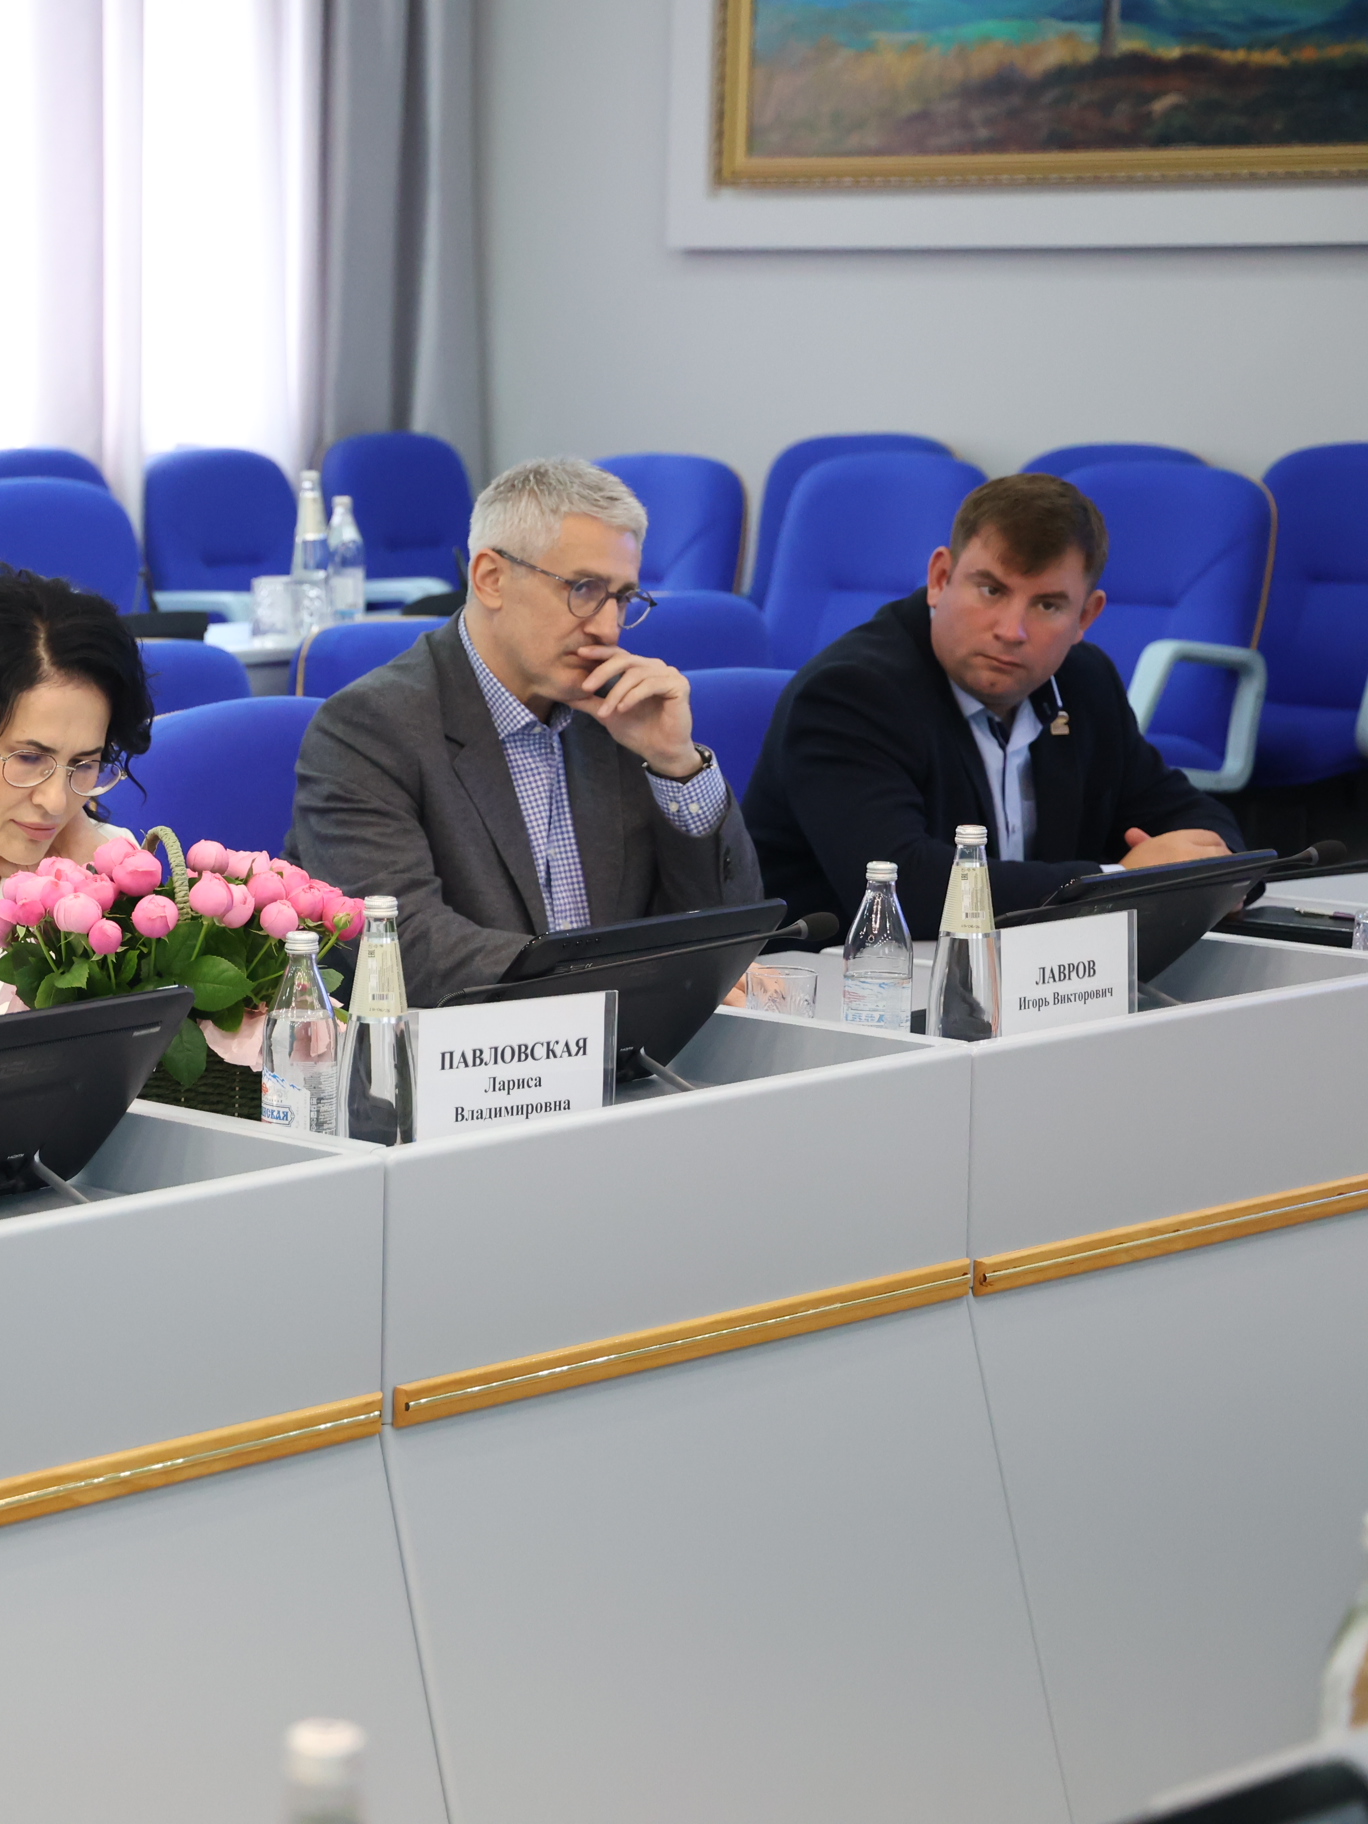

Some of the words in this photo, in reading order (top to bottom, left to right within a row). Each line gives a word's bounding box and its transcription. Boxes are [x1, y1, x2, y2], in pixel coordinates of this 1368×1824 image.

[1035, 959, 1096, 986] ЛАВРОВ
[1018, 996, 1050, 1012] Игорь
[1052, 987, 1113, 1005] Викторович
[439, 1036, 589, 1071] ПАВЛОВСКАЯ
[484, 1075, 543, 1095] Лариса
[454, 1098, 572, 1123] Владимировна
